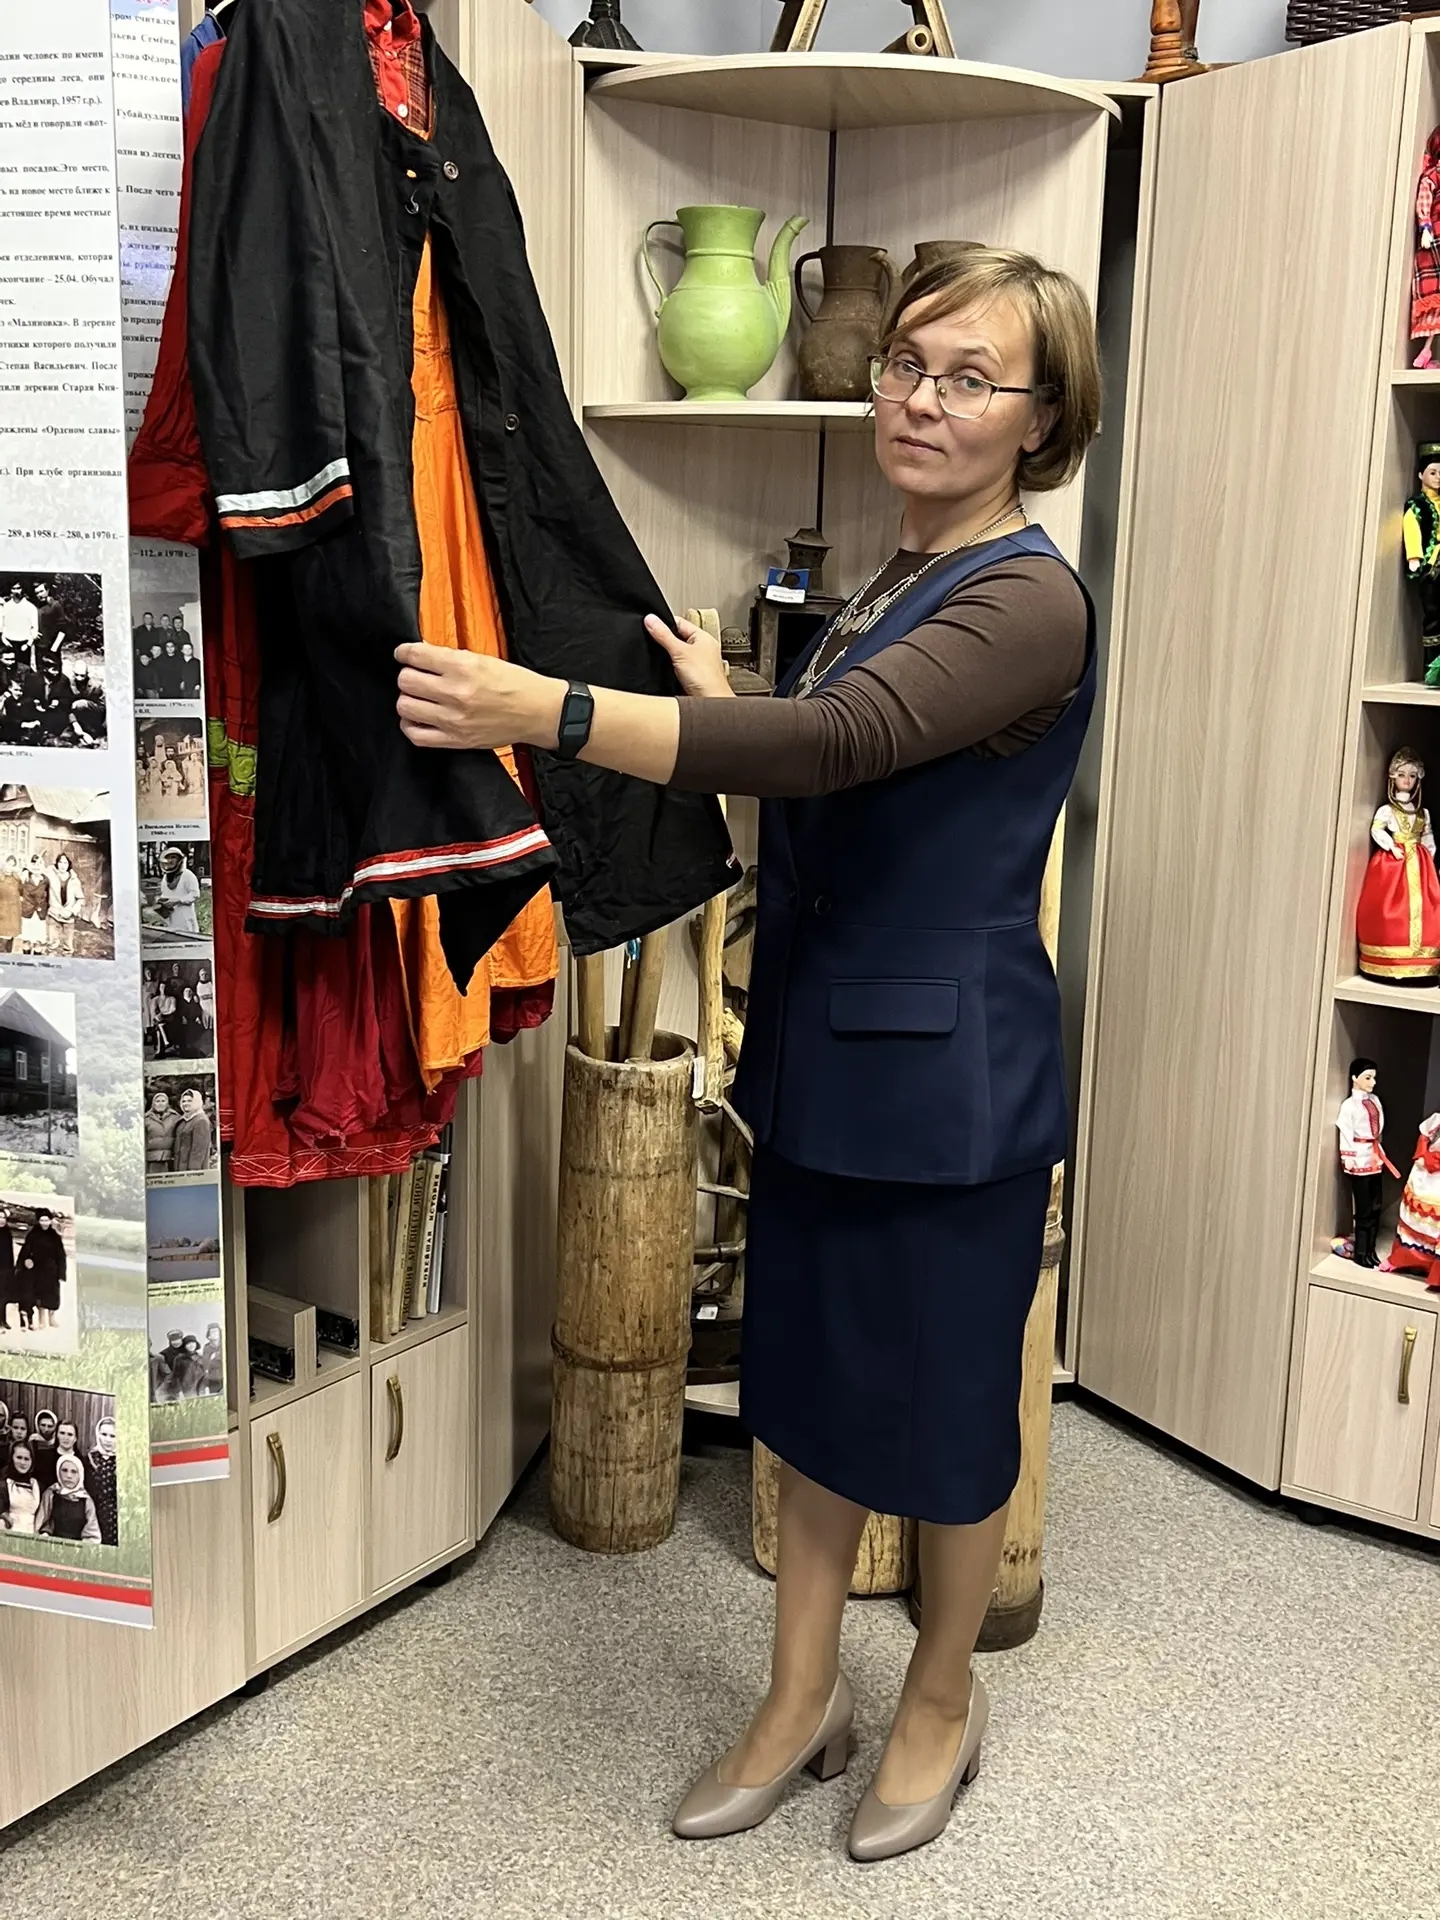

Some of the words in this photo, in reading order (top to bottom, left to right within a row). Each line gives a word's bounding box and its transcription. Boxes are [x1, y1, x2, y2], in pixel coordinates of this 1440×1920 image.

[135, 15, 175, 25] считался
[23, 52, 59, 60] человек
[12, 76, 56, 86] середины
[60, 75, 84, 83] леса,
[11, 97, 60, 107] Владимир,
[62, 96, 81, 104] 1957
[117, 108, 179, 122] Губайдуллина
[16, 120, 32, 128] мёд
[40, 120, 82, 129] говорили
[75, 186, 103, 194] ближе
[126, 185, 152, 194] После
[44, 210, 71, 219] время
[14, 254, 74, 262] отделениями,
[78, 253, 113, 263] которая
[54, 273, 79, 284] 25.04.
[81, 273, 114, 285] Обучал
[8, 317, 70, 327] «Малиновка».
[73, 318, 79, 326] В
[82, 321, 116, 329] деревне
[33, 341, 71, 350] которого
[74, 340, 116, 350] получили
[34, 361, 88, 370] Васильевич.
[92, 361, 118, 370] После
[24, 384, 59, 393] деревни
[62, 382, 94, 393] Старая
[98, 382, 119, 391] Кня-
[42, 425, 85, 436] «Орденом
[16, 467, 34, 477] При
[39, 467, 63, 478] клубе
[68, 470, 122, 478] организован
[8, 529, 25, 539] 289,
[33, 529, 52, 538] 1958
[67, 530, 84, 540] 280,
[93, 531, 111, 539] 1970
[407, 1210, 419, 1260] ДРЕВНЕГО
[413, 1176, 424, 1207] МИРА
[422, 1231, 432, 1288] НОВЕЙШАЯ
[428, 1174, 439, 1221] ИСТОРИЯ
